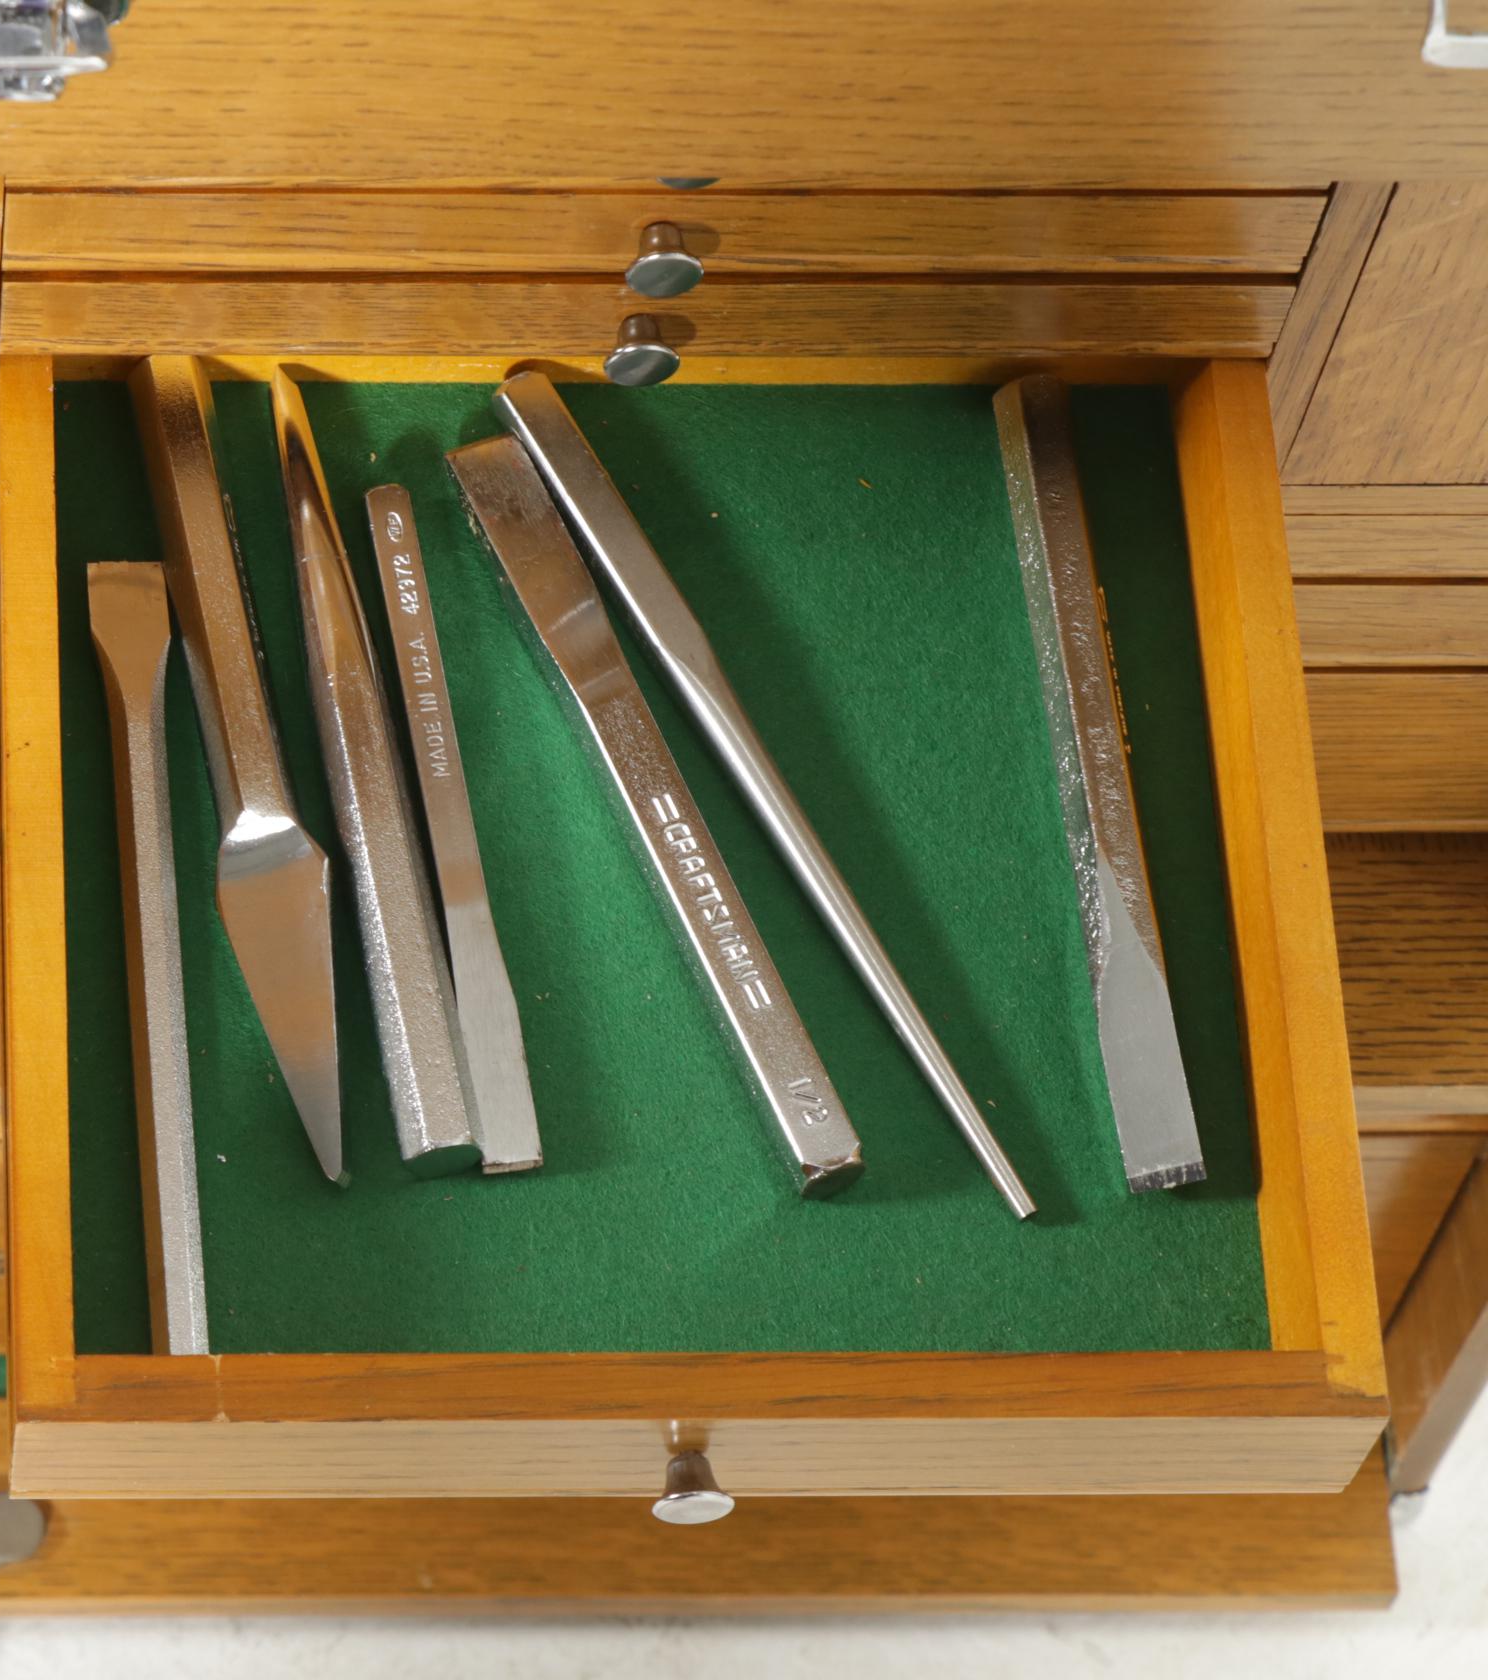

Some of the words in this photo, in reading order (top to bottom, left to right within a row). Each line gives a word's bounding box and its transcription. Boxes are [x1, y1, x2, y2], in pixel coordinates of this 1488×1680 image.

[417, 692, 439, 713] IN
[423, 720, 452, 778] MADE
[787, 1077, 829, 1126] 1/2
